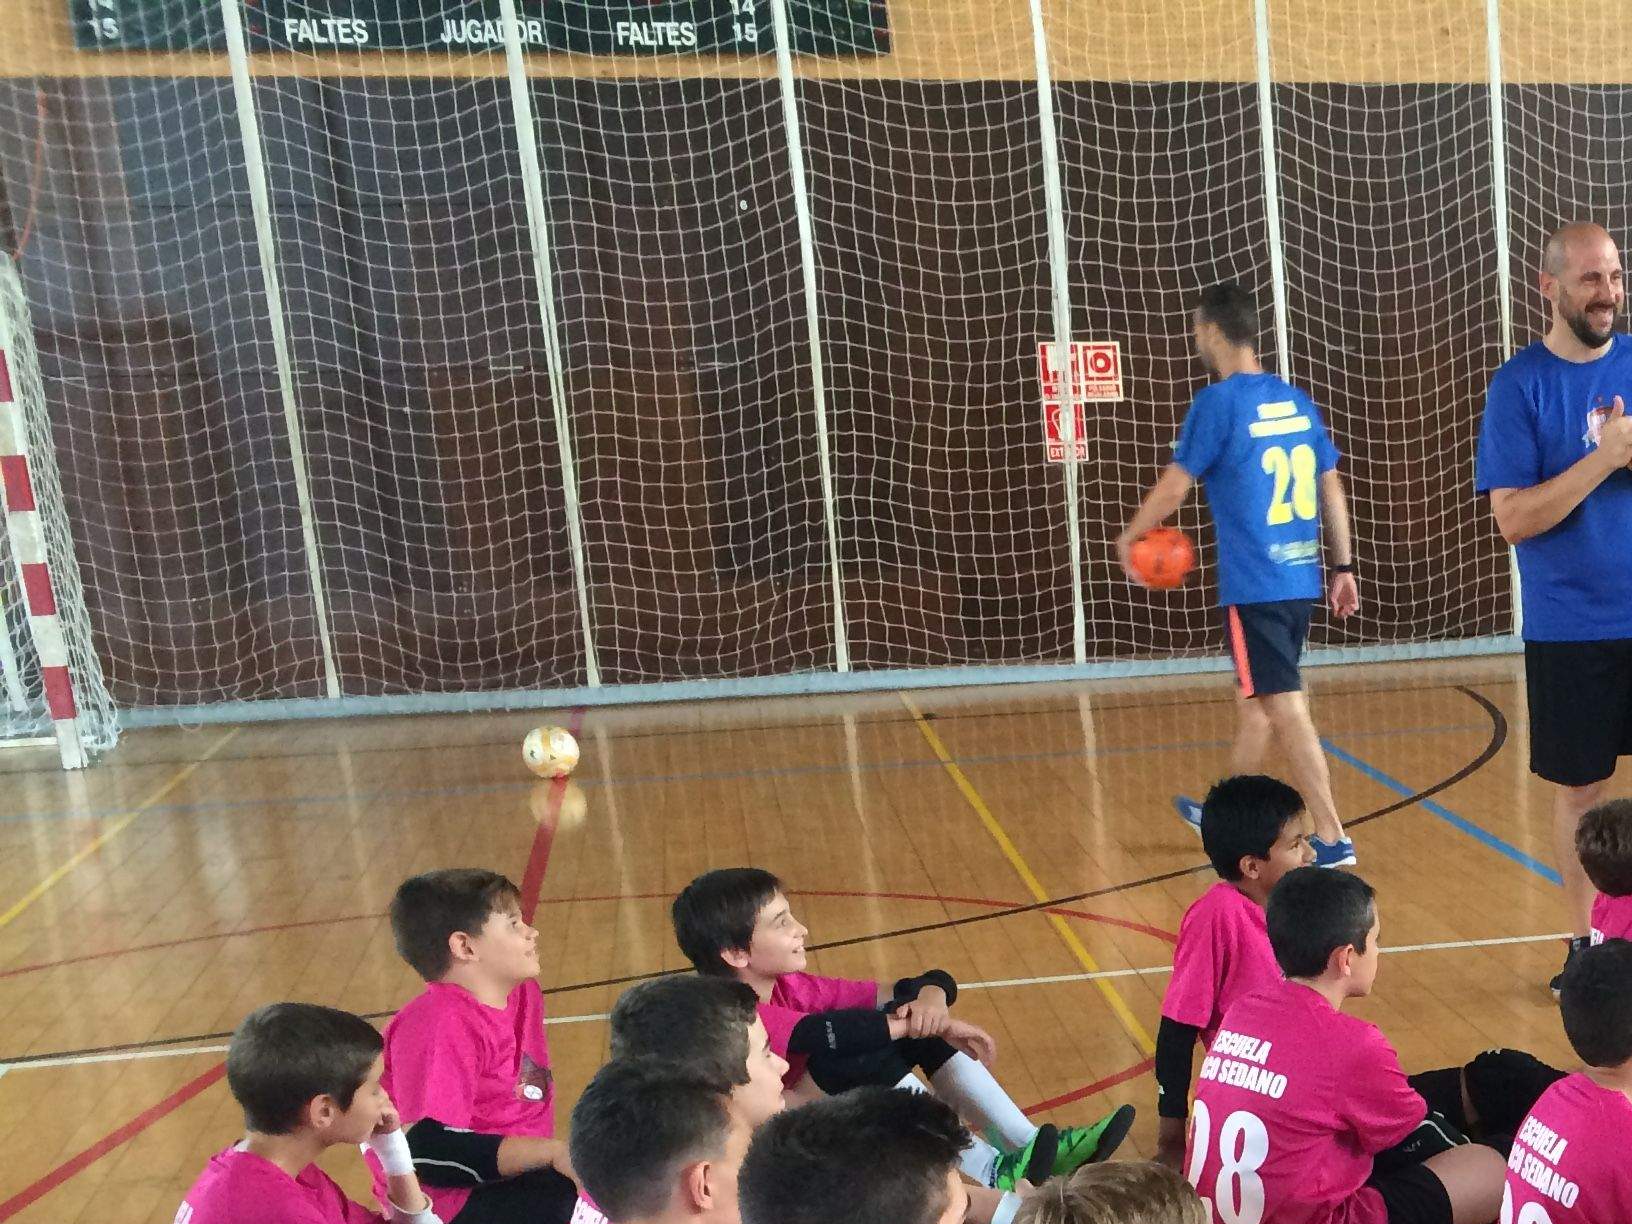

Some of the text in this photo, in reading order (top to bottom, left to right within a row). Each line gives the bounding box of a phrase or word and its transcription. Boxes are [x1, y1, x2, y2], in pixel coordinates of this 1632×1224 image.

[285, 18, 368, 44] FALTES
[617, 21, 697, 46] FALTES
[732, 23, 757, 42] 15
[1218, 1058, 1288, 1099] SEDANO
[1520, 1153, 1580, 1209] SEDANO
